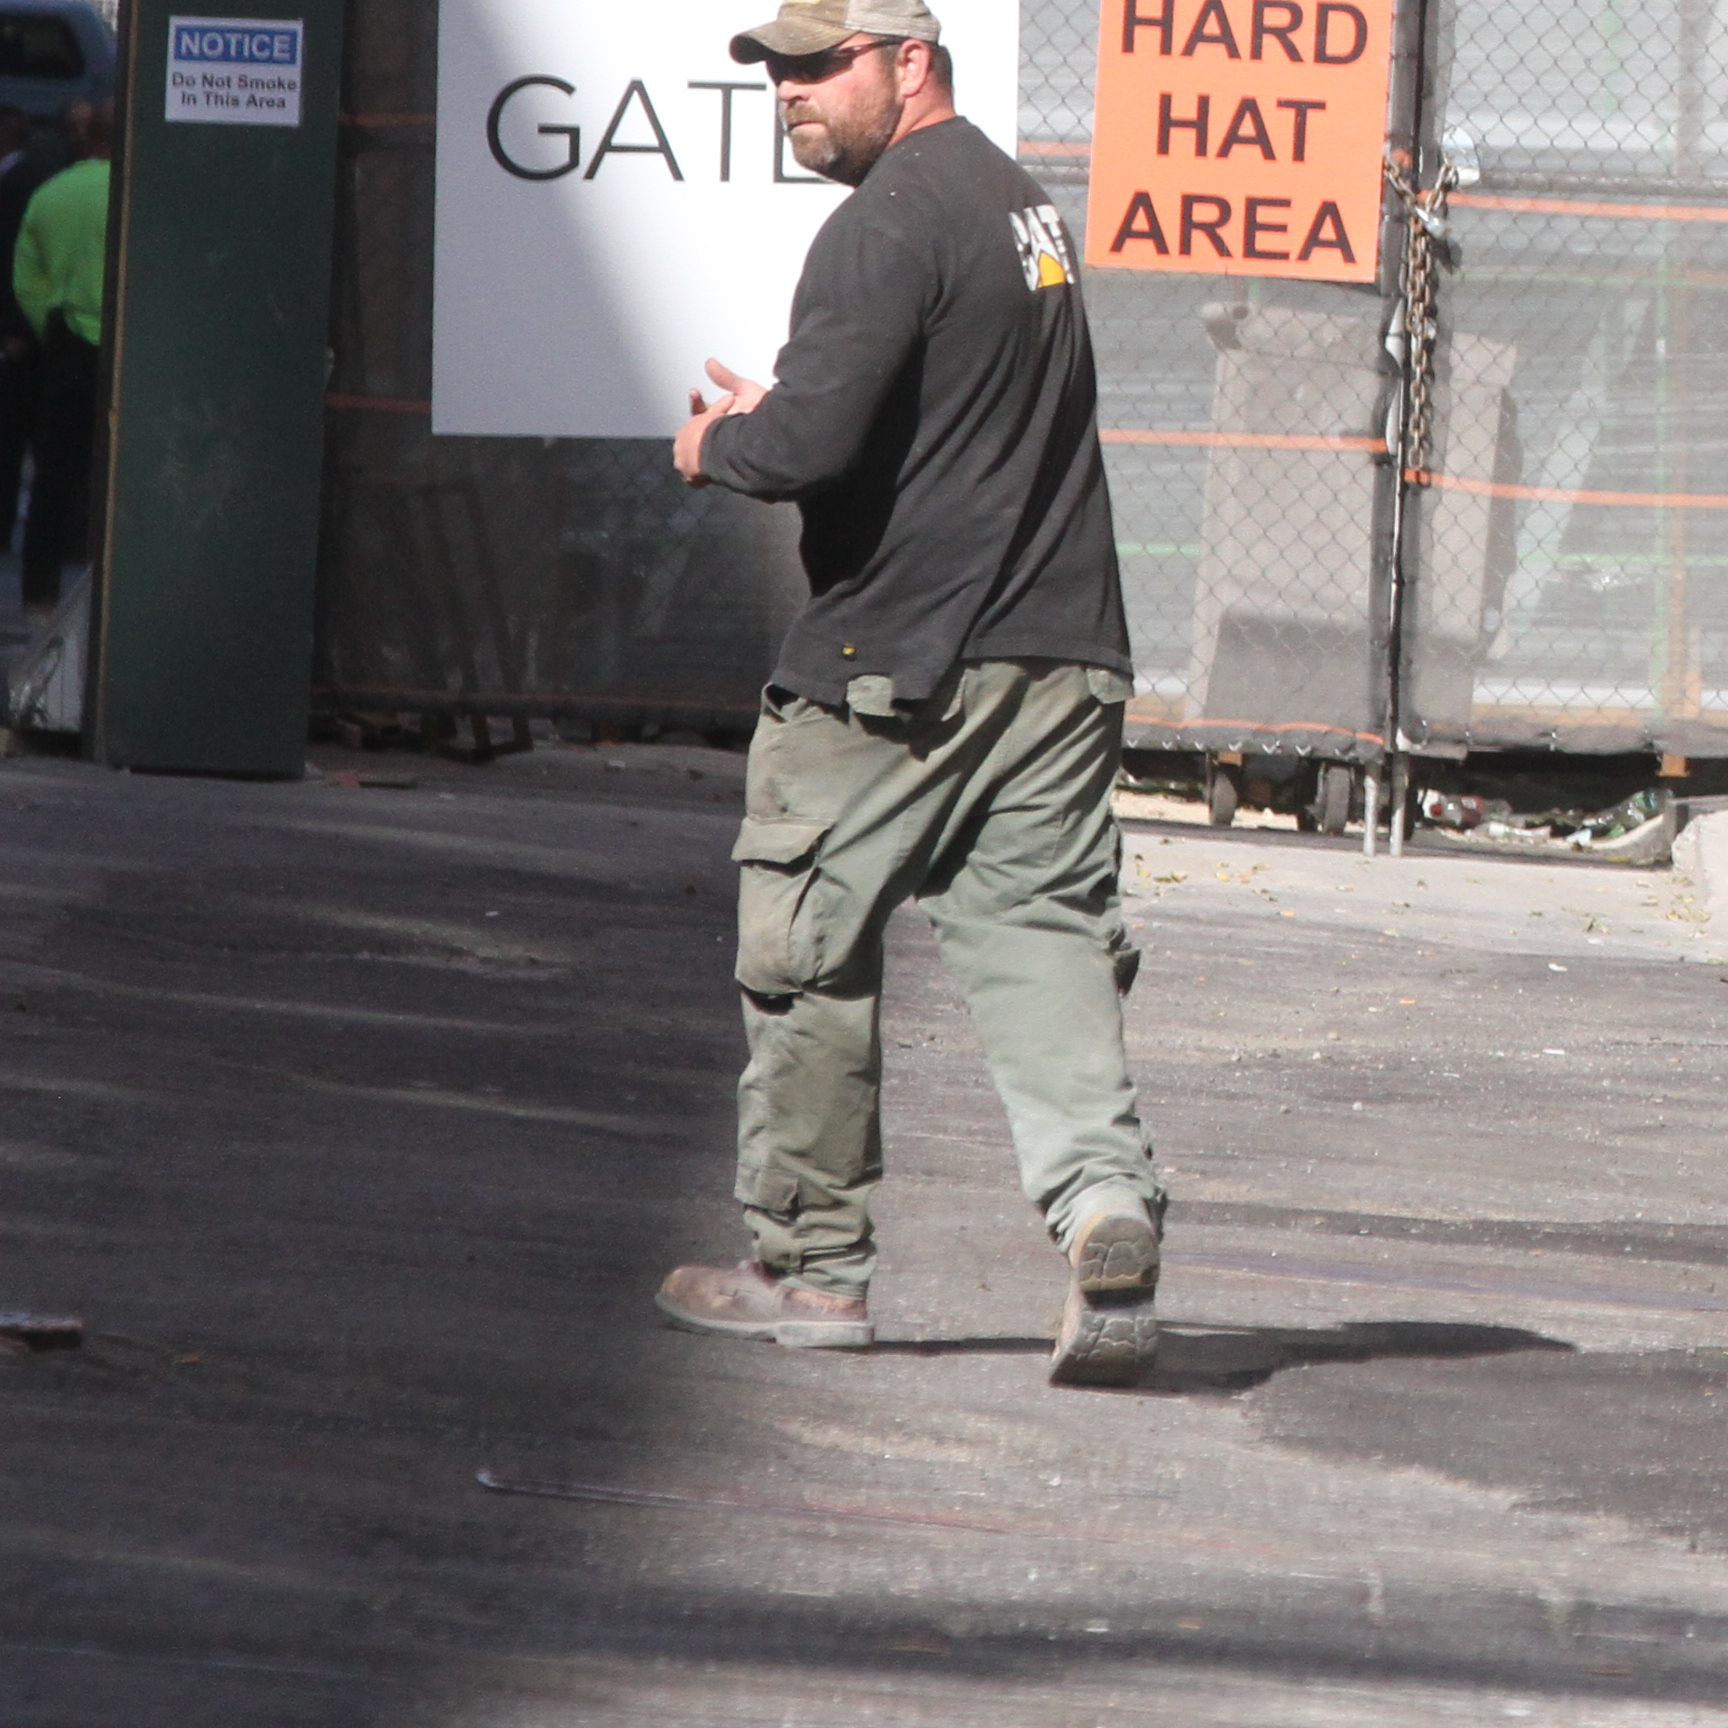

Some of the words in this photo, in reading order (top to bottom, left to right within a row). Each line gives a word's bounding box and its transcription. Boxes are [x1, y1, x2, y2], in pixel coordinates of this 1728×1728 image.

[180, 31, 291, 60] NOTICE
[172, 72, 195, 87] Do
[202, 73, 231, 88] Not
[238, 74, 297, 91] Smoke
[181, 91, 197, 106] In
[204, 92, 239, 107] This
[246, 94, 286, 109] Area
[1157, 91, 1327, 162] HAT
[1108, 190, 1357, 264] AREA
